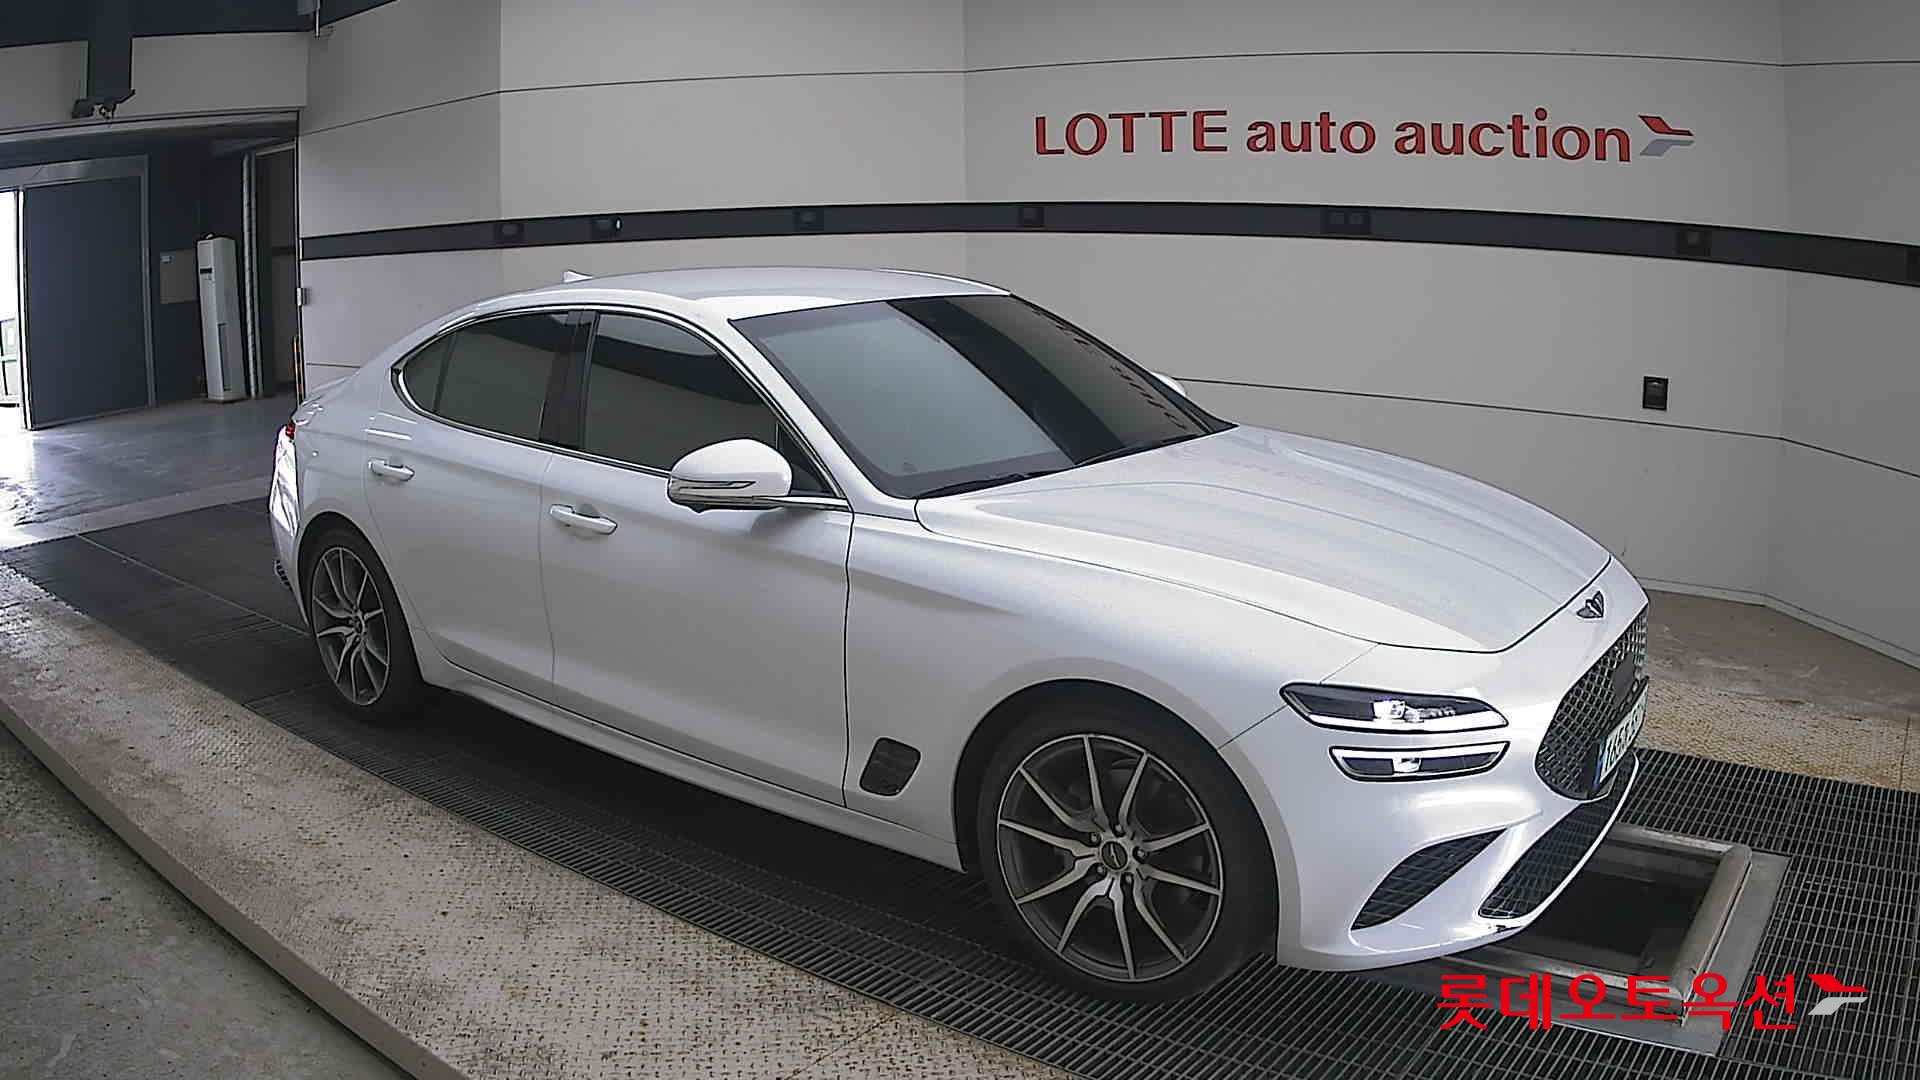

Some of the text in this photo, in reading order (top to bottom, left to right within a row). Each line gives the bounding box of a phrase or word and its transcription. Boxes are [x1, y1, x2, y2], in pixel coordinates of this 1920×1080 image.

[1035, 108, 1632, 162] LOTTE auto auction
